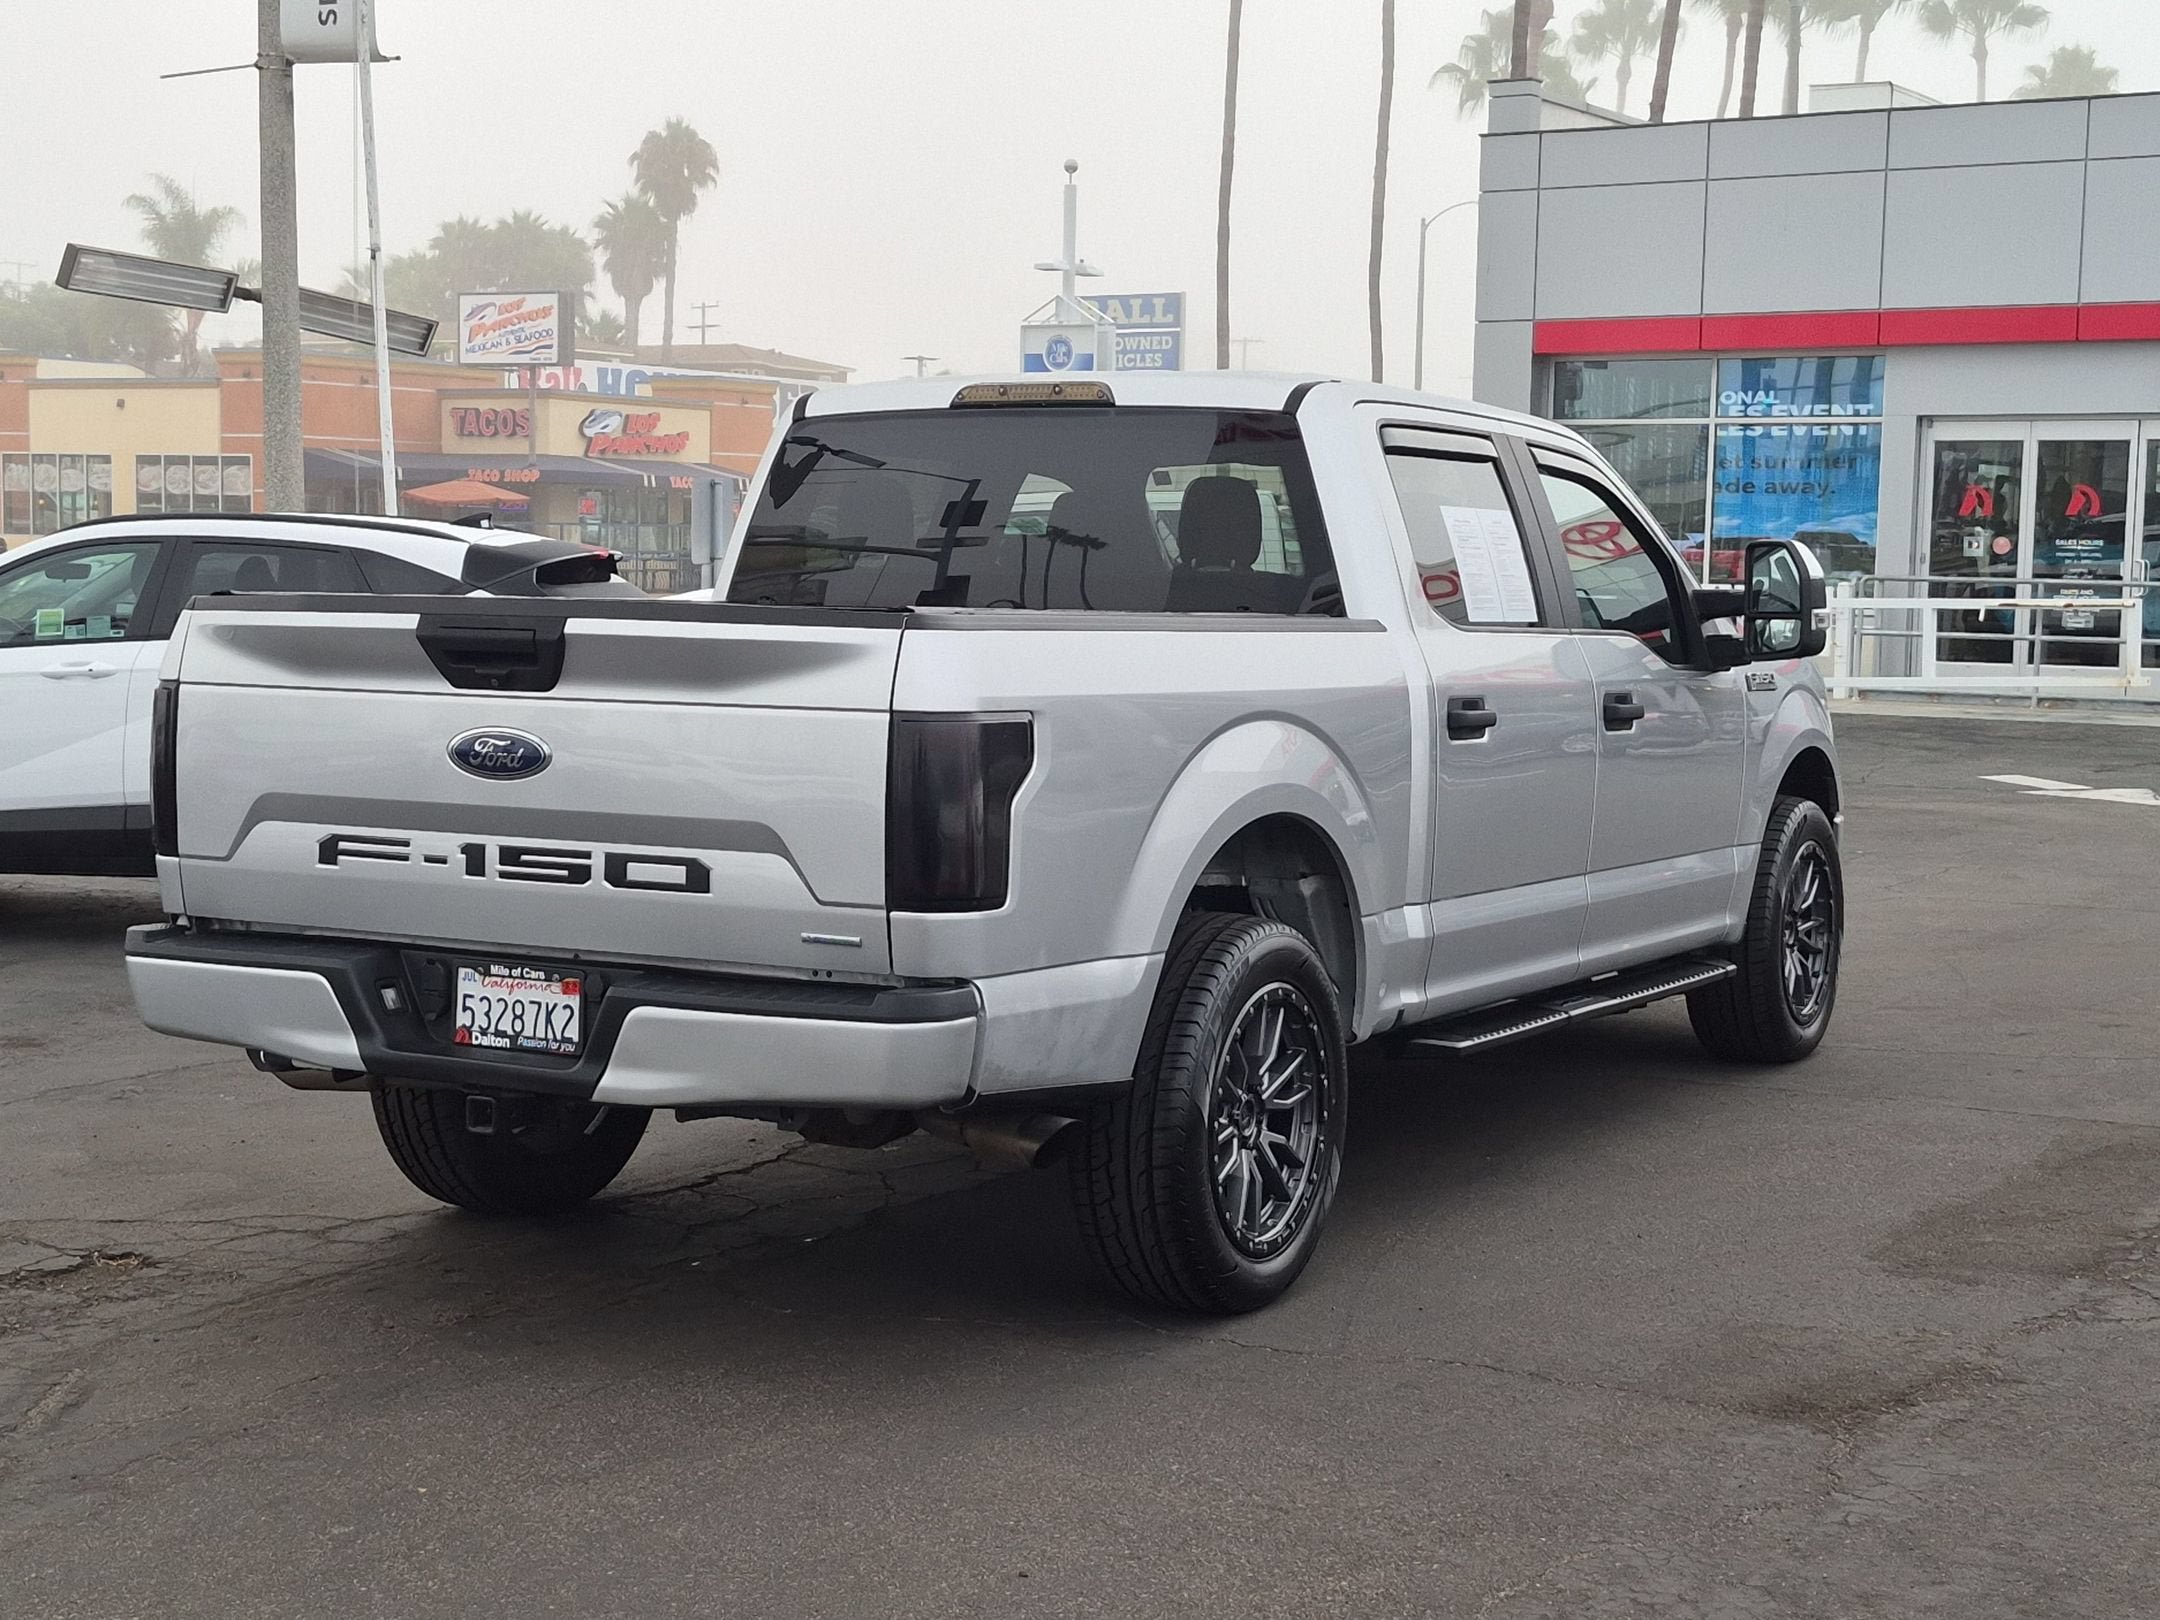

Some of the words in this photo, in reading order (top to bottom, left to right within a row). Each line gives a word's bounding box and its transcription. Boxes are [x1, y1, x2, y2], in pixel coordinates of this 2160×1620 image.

[465, 340, 503, 354] MEXICAN
[513, 328, 554, 344] SEAFOOD
[1116, 336, 1173, 350] OWNED
[450, 407, 529, 437] TACOS
[626, 412, 661, 434] LOS
[1771, 403, 1874, 437] EVENT
[588, 431, 690, 458] PANCHOS
[467, 468, 500, 482] TACO
[504, 468, 540, 483] SHOP
[1764, 481, 1836, 498] away.
[470, 738, 525, 768] Ford
[315, 833, 712, 896] F-150
[462, 971, 477, 982] JUL
[490, 964, 510, 976] Mile
[511, 966, 521, 977] of
[523, 967, 545, 980] Cars
[481, 976, 561, 996] California
[462, 993, 575, 1041] 53287K2
[471, 1031, 510, 1049] Dalton
[560, 1041, 576, 1052] you
